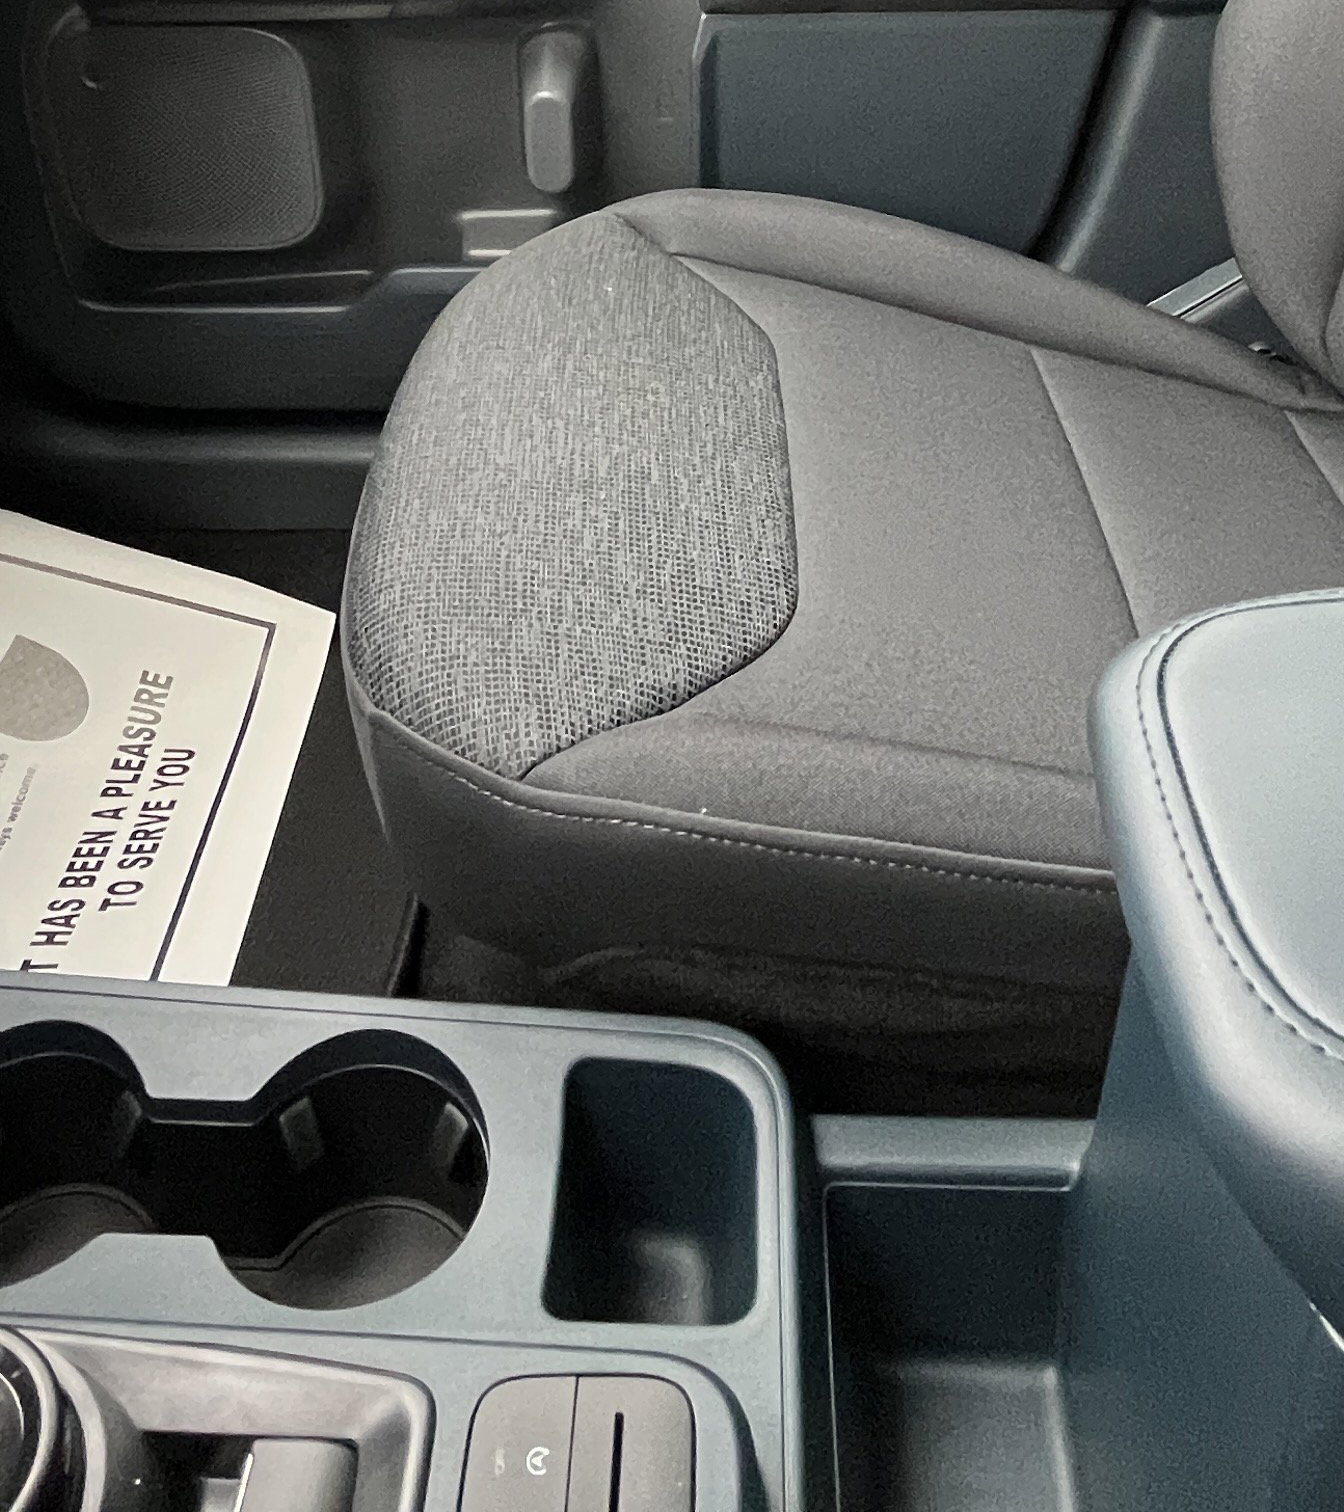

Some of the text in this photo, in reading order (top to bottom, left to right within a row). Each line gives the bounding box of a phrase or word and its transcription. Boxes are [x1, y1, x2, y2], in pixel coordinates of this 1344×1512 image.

[19, 669, 174, 973] T HAS BEEN A PLEASURE
[98, 748, 196, 912] TO SERVE YOU
